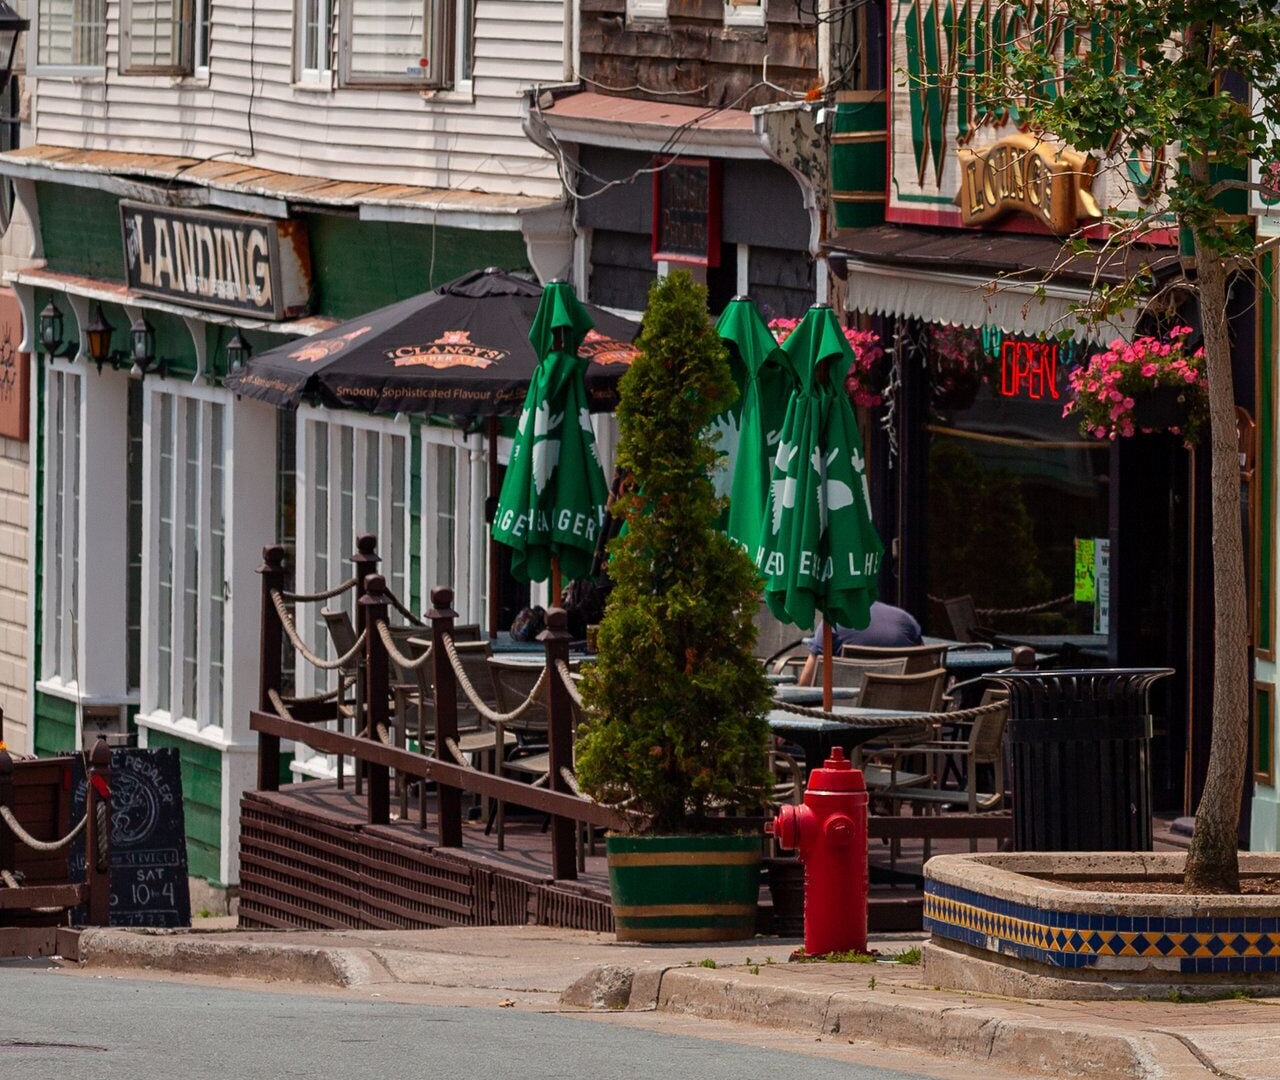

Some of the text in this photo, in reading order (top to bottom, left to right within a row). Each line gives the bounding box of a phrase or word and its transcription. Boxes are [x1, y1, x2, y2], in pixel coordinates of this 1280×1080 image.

[135, 214, 273, 307] LANDING
[1001, 340, 1059, 400] OPEN
[336, 385, 380, 398] Smooth,
[382, 386, 452, 402] Sophisticated
[453, 389, 491, 399] Flavour
[137, 868, 165, 881] SAT
